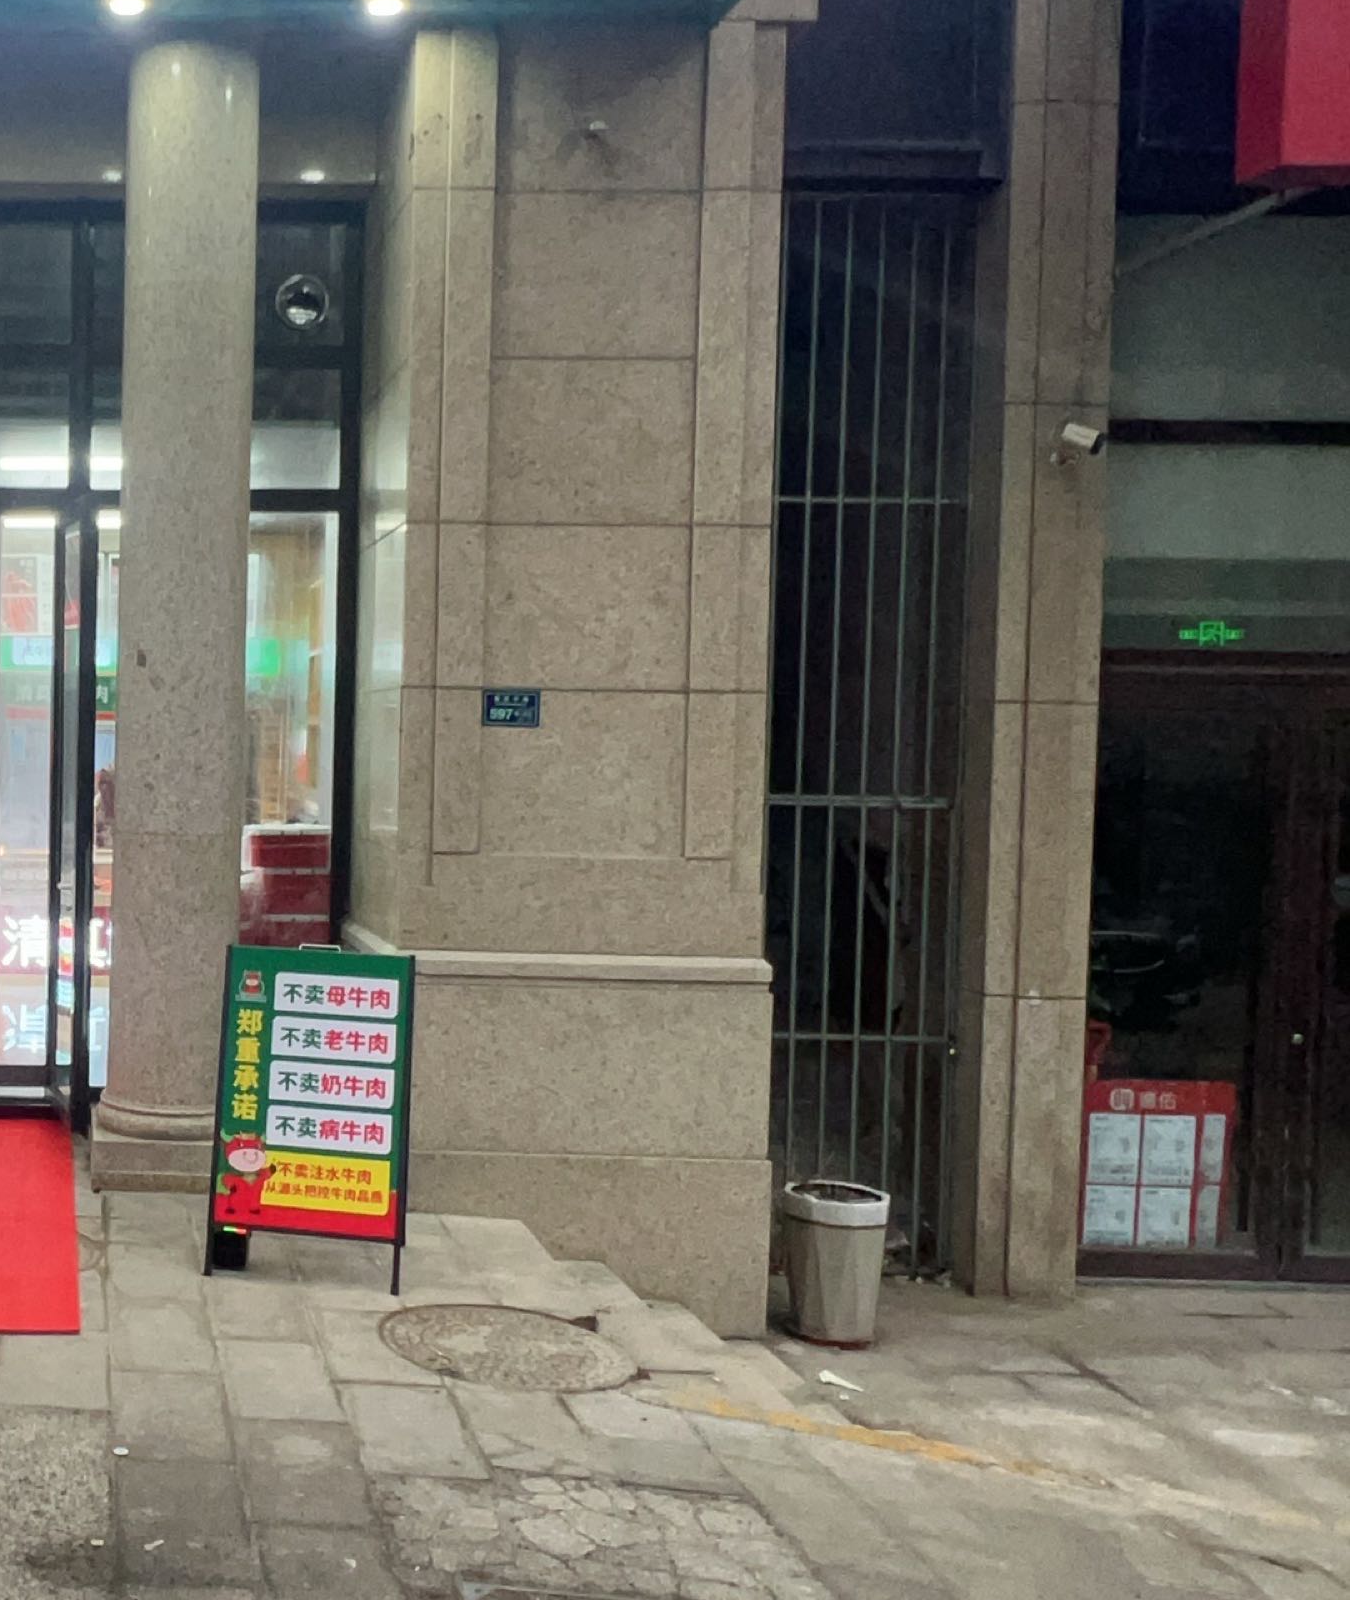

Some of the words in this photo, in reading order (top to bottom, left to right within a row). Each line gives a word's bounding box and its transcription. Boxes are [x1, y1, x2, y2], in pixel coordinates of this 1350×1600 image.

[282, 983, 390, 1010] 不卖母牛肉
[280, 1026, 388, 1054] 不卖老牛肉
[231, 1008, 264, 1120] 郑重承诺
[278, 1070, 386, 1099] 不卖奶牛肉
[275, 1115, 384, 1144] 不卖病牛肉
